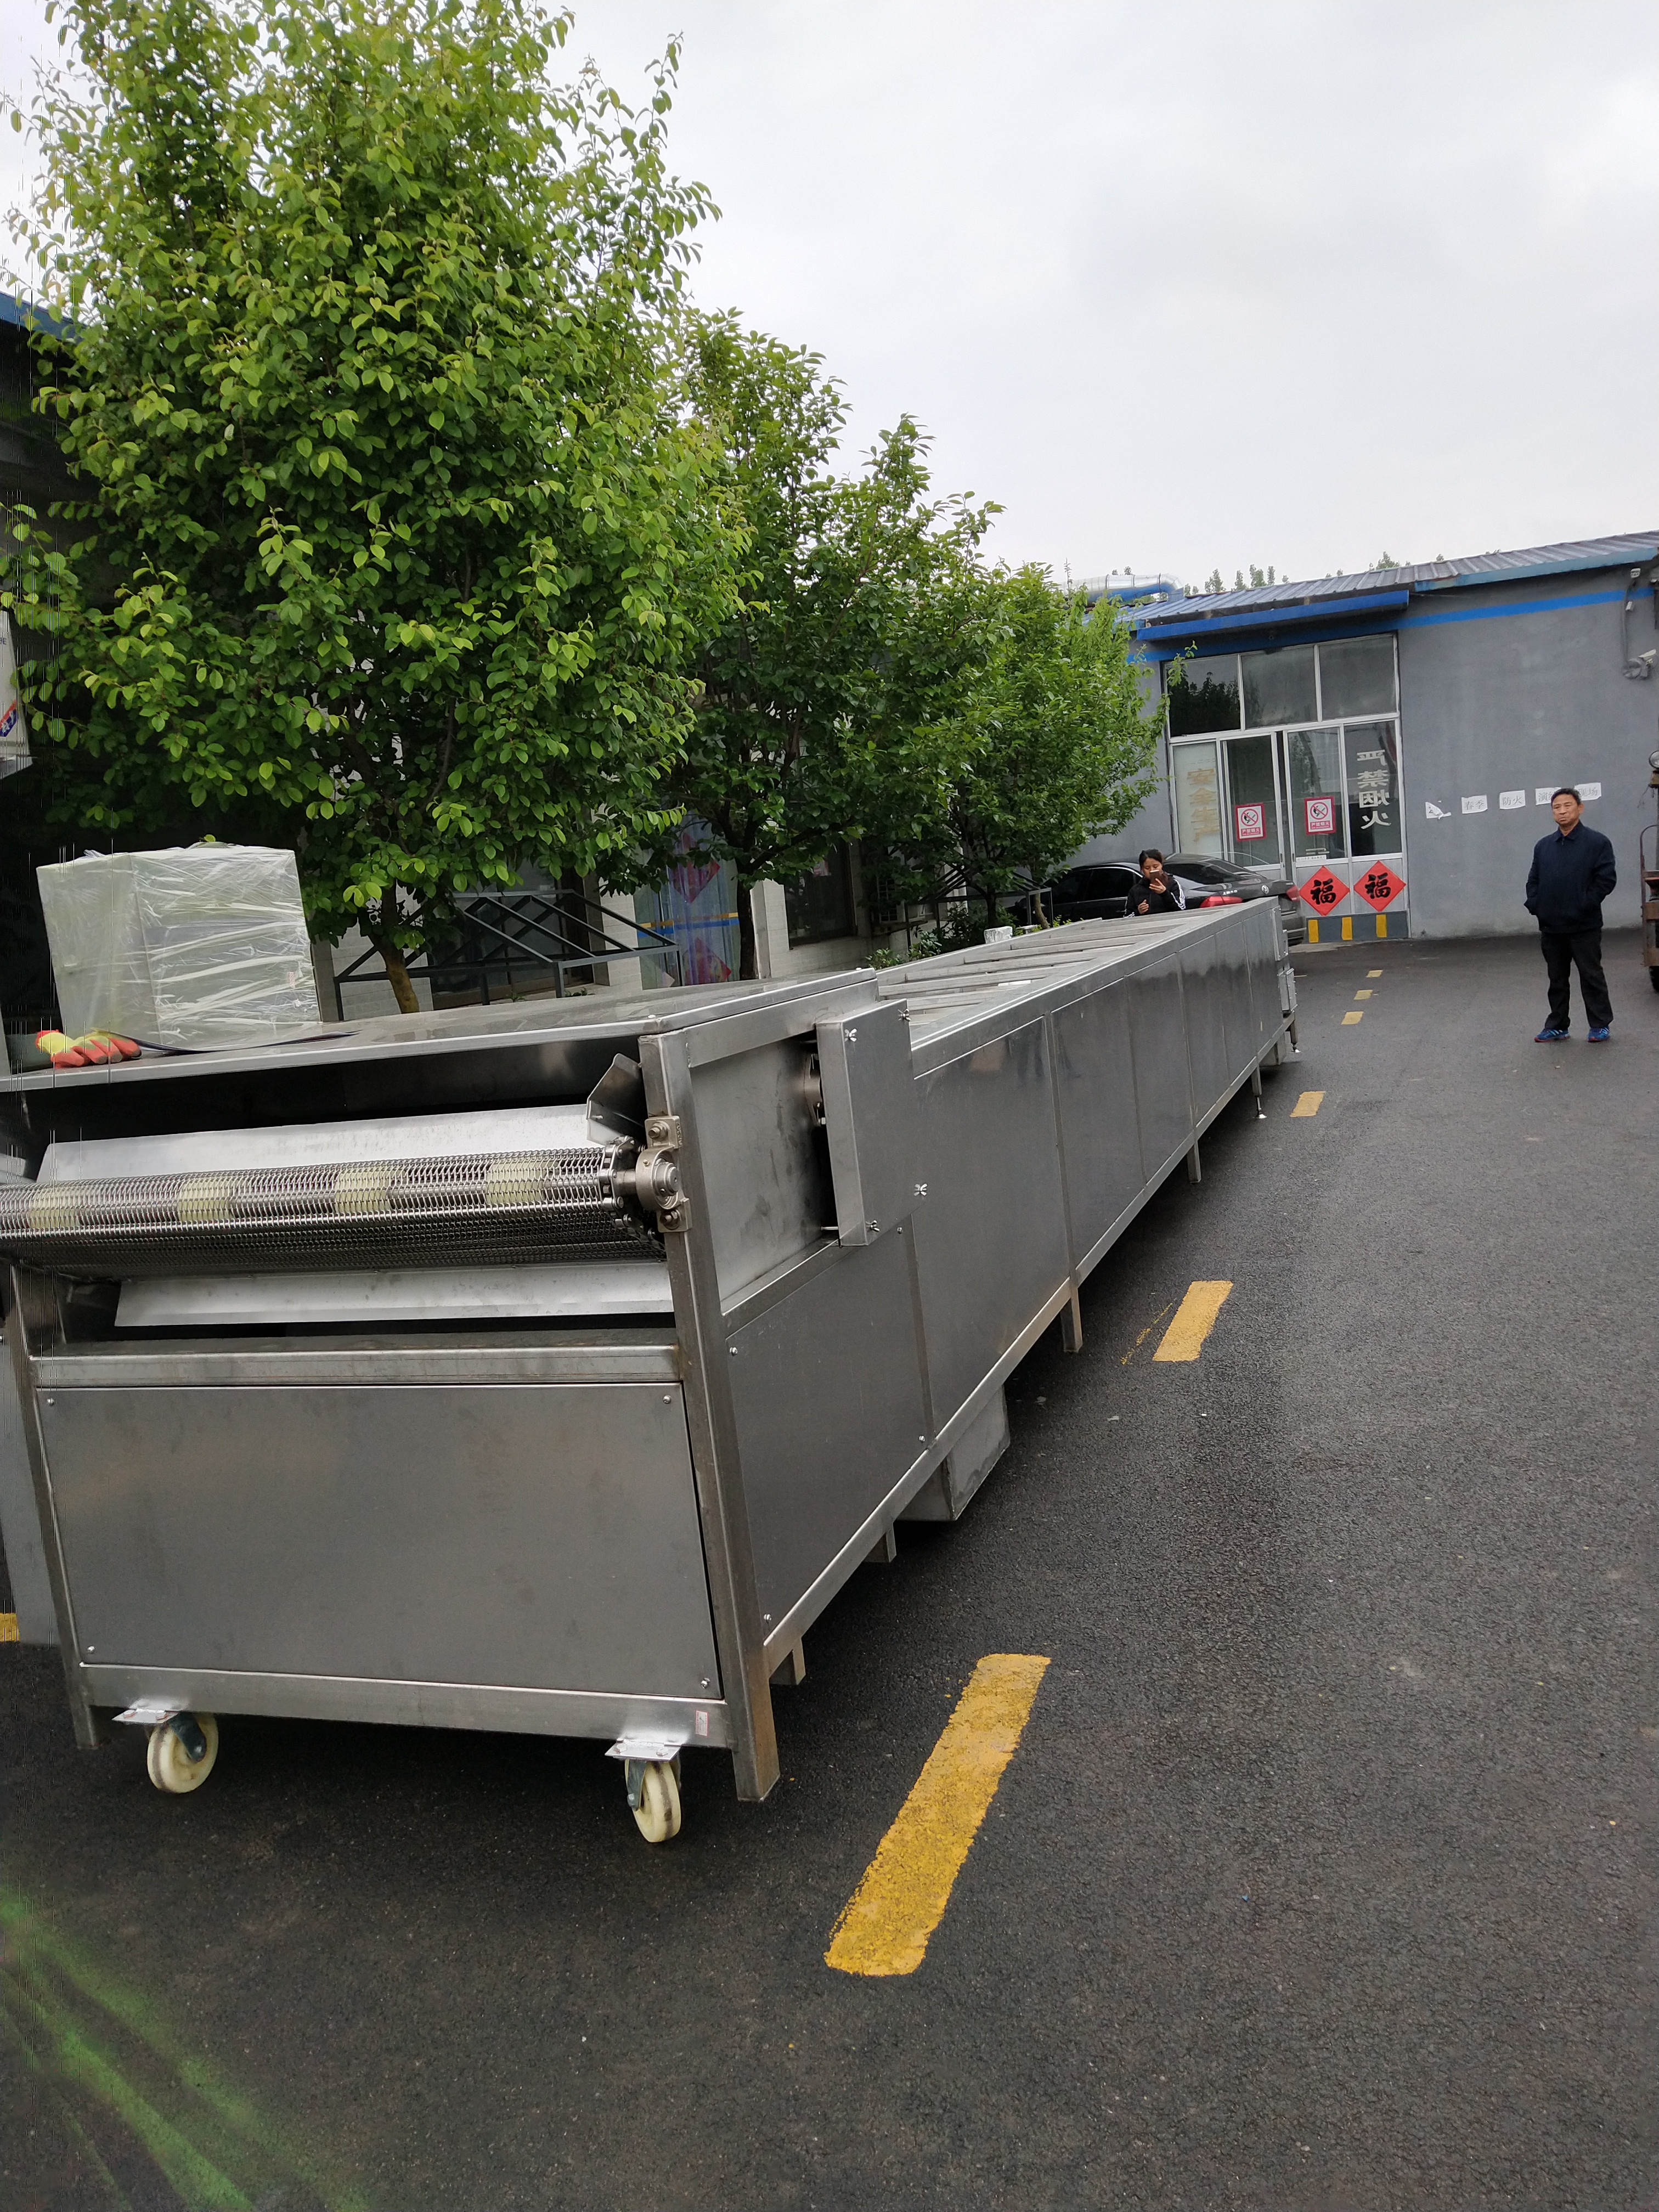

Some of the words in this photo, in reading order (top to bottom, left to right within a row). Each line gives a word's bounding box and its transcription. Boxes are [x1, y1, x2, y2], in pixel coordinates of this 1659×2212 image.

[1502, 795, 1522, 806] 防火
[1310, 878, 1336, 905] 福
[1364, 872, 1391, 899] 福
